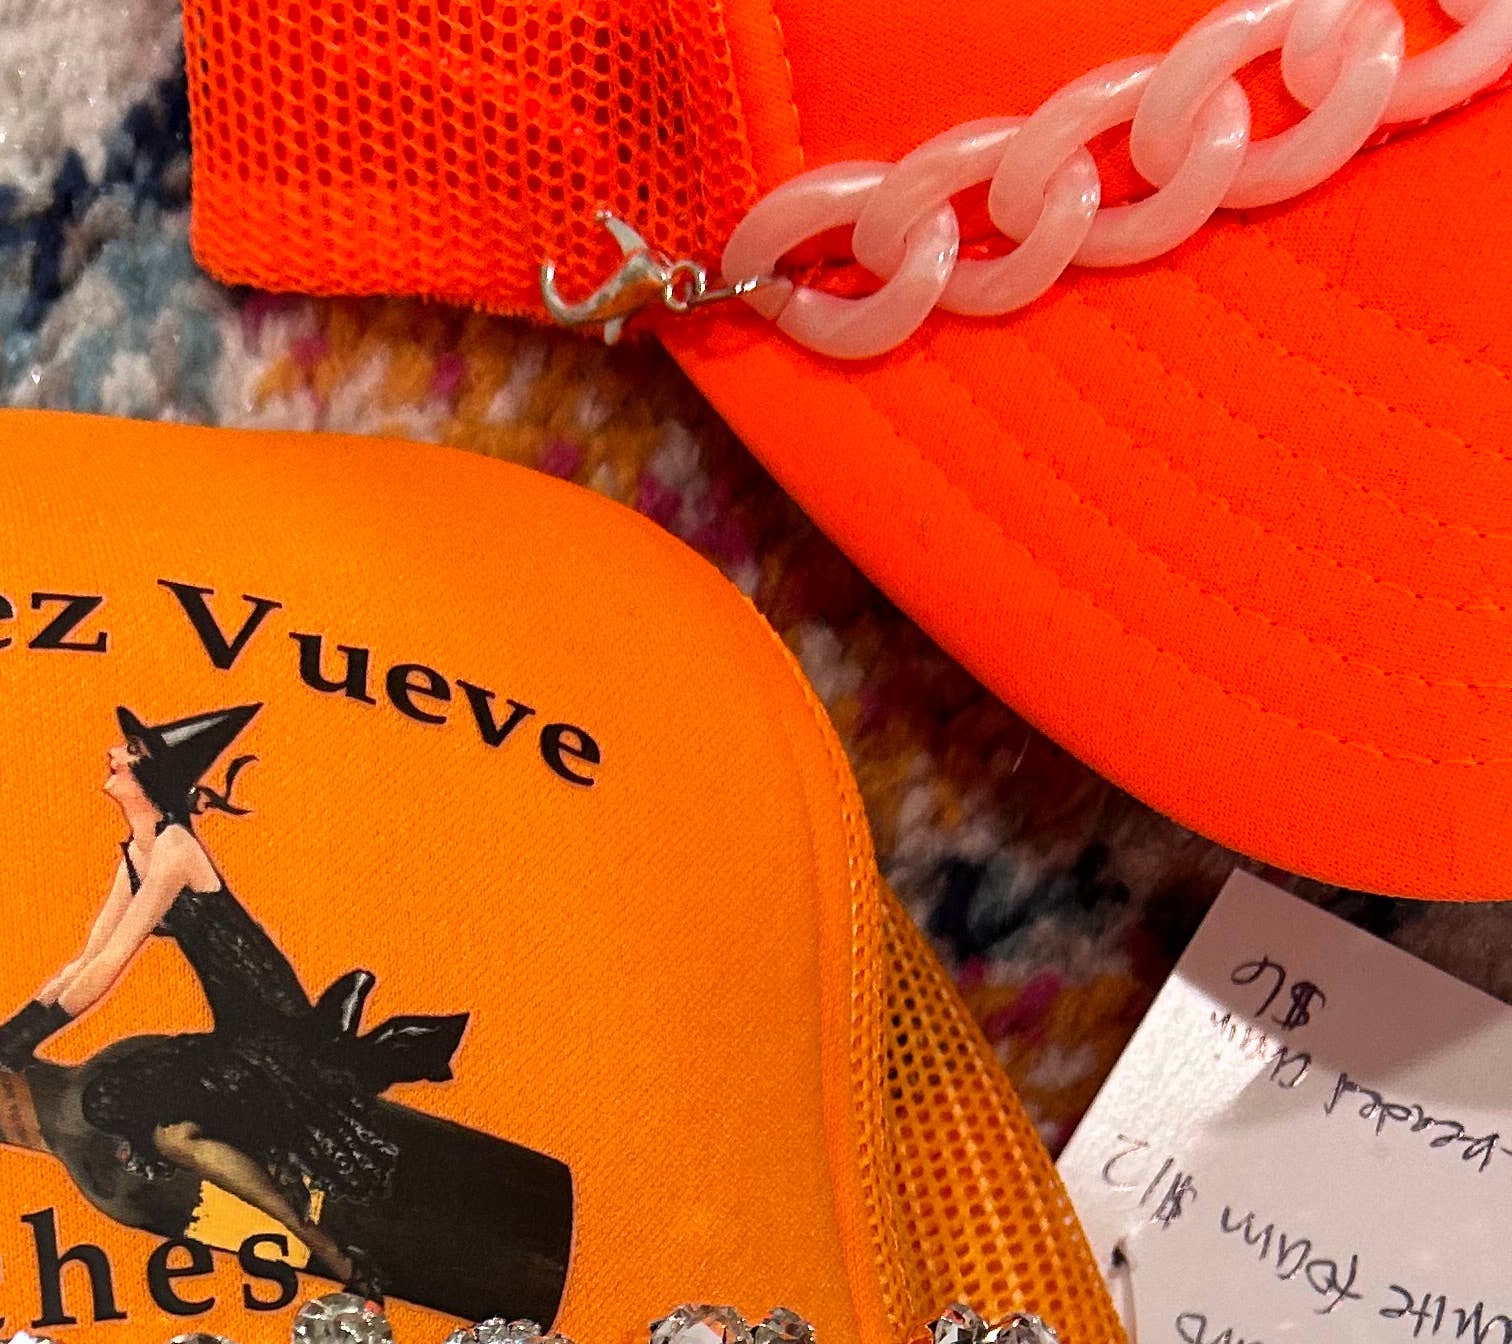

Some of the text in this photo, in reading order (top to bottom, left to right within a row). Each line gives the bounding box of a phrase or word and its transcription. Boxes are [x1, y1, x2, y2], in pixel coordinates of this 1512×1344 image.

[158, 577, 603, 788] Vueve
[1231, 954, 1327, 1031] $6
[1101, 1133, 1198, 1231] $12
[1220, 1205, 1363, 1315] foam
